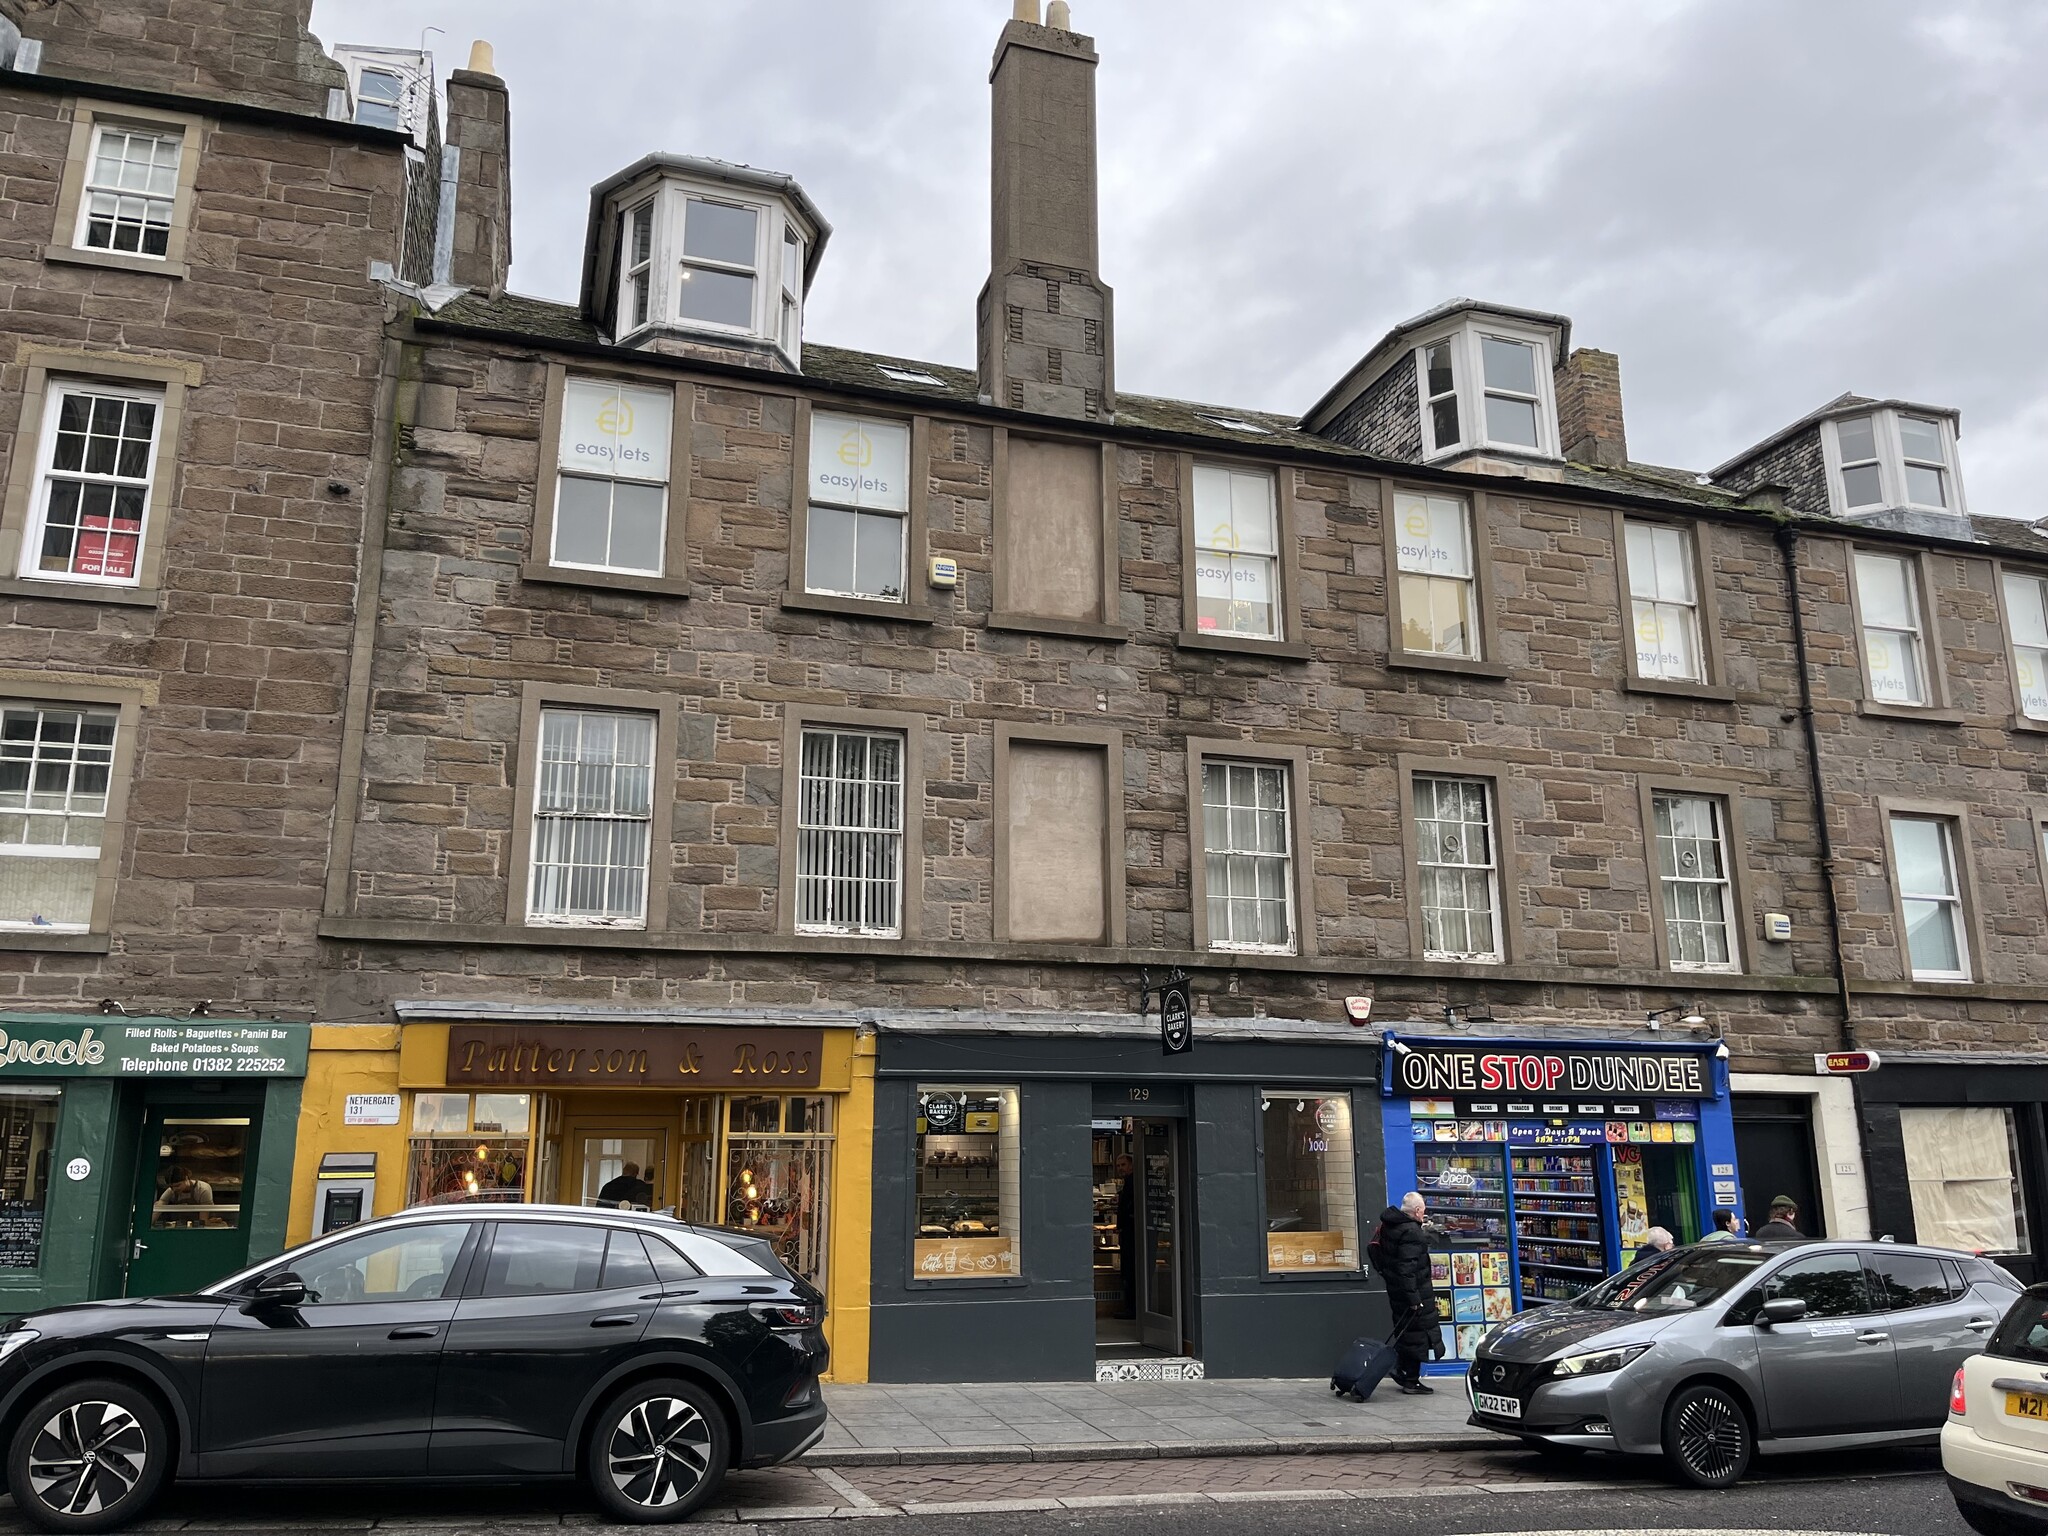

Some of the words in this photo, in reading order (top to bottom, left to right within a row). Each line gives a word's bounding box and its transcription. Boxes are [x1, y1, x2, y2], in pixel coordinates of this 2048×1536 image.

[82, 563, 100, 571] FOR
[1166, 1011, 1185, 1022] CLARK'S
[1167, 1021, 1185, 1031] BAKERY
[125, 1028, 151, 1038] Filled
[153, 1028, 177, 1038] Rolls
[186, 1029, 232, 1040] Baguettes
[241, 1029, 269, 1039] Panini
[271, 1029, 287, 1039] Bar
[150, 1043, 179, 1053] Baked
[182, 1043, 222, 1053] Potatoes
[231, 1043, 259, 1054] Soups
[461, 1039, 649, 1074] Patterson
[679, 1042, 703, 1075] &
[732, 1043, 812, 1075] Ross
[1827, 1058, 1849, 1067] EASY
[121, 1057, 188, 1074] Telephone
[192, 1057, 232, 1072] 01382
[237, 1057, 286, 1072] 225252
[1403, 1053, 1476, 1090] ONE
[1480, 1054, 1565, 1091] STOP
[1569, 1056, 1703, 1092] DUNDEE
[1128, 1088, 1150, 1100] 129
[349, 1096, 395, 1105] NETHERGATE
[349, 1106, 363, 1115] 131
[1512, 1127, 1533, 1136] Open
[1535, 1129, 1540, 1137] 7
[1545, 1127, 1565, 1137] Days
[1579, 1128, 1602, 1136] Week
[69, 1164, 87, 1175] 133
[1442, 1171, 1469, 1187] Open
[1479, 1395, 1499, 1411] GK22
[2019, 1397, 2043, 1416] M21
